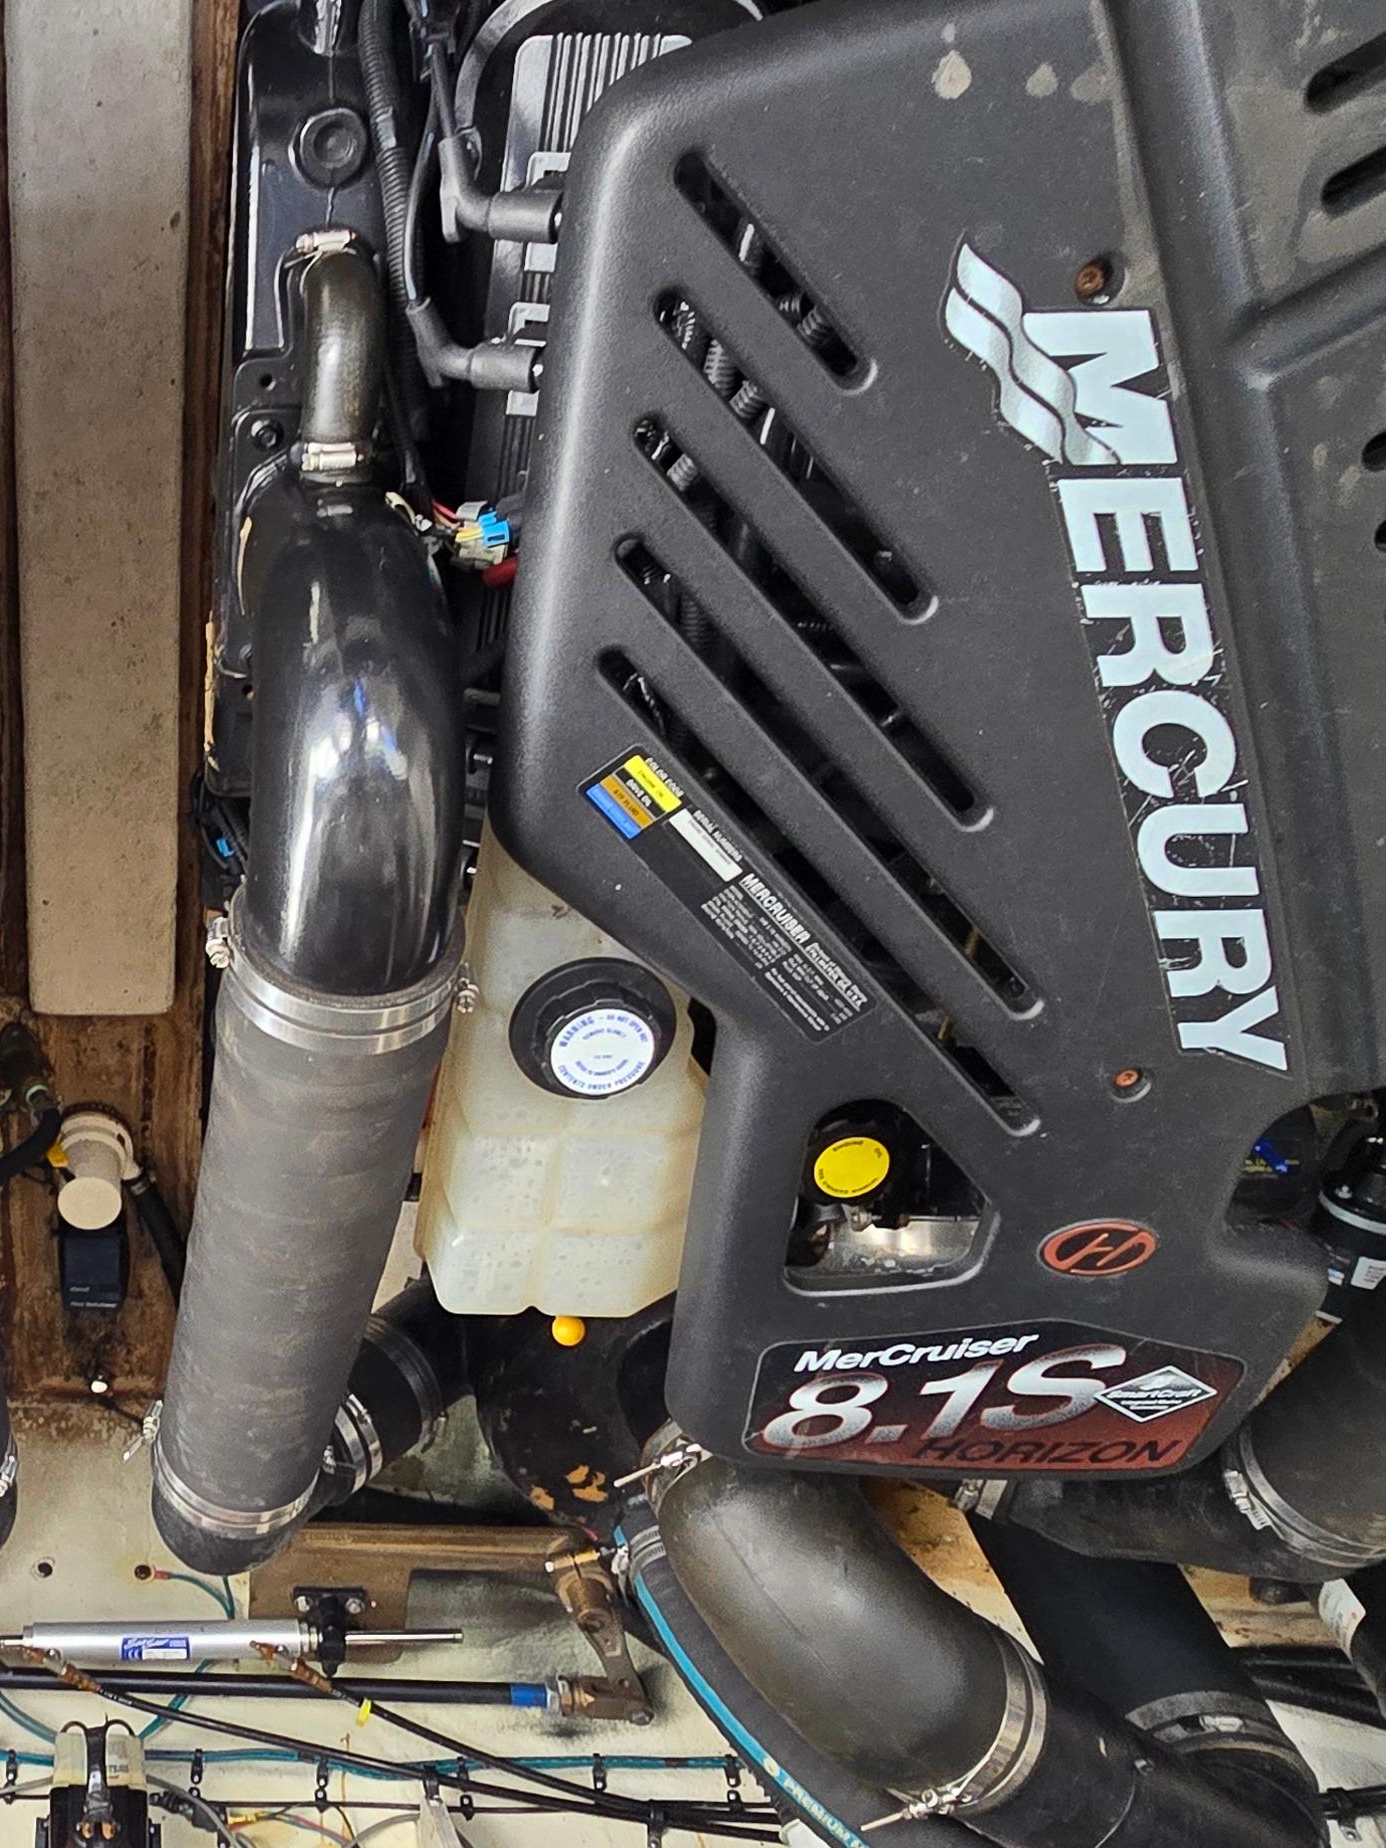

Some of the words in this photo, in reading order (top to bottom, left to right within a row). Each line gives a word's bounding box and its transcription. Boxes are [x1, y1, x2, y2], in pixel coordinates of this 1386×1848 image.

[1019, 306, 1289, 1072] MERCURY
[739, 872, 812, 944] MERCRUISER
[558, 1015, 595, 1047] WARNING
[793, 1332, 1040, 1373] MerCruiser
[762, 1343, 1127, 1448] 8.1S
[915, 1436, 1184, 1464] HORIZON
